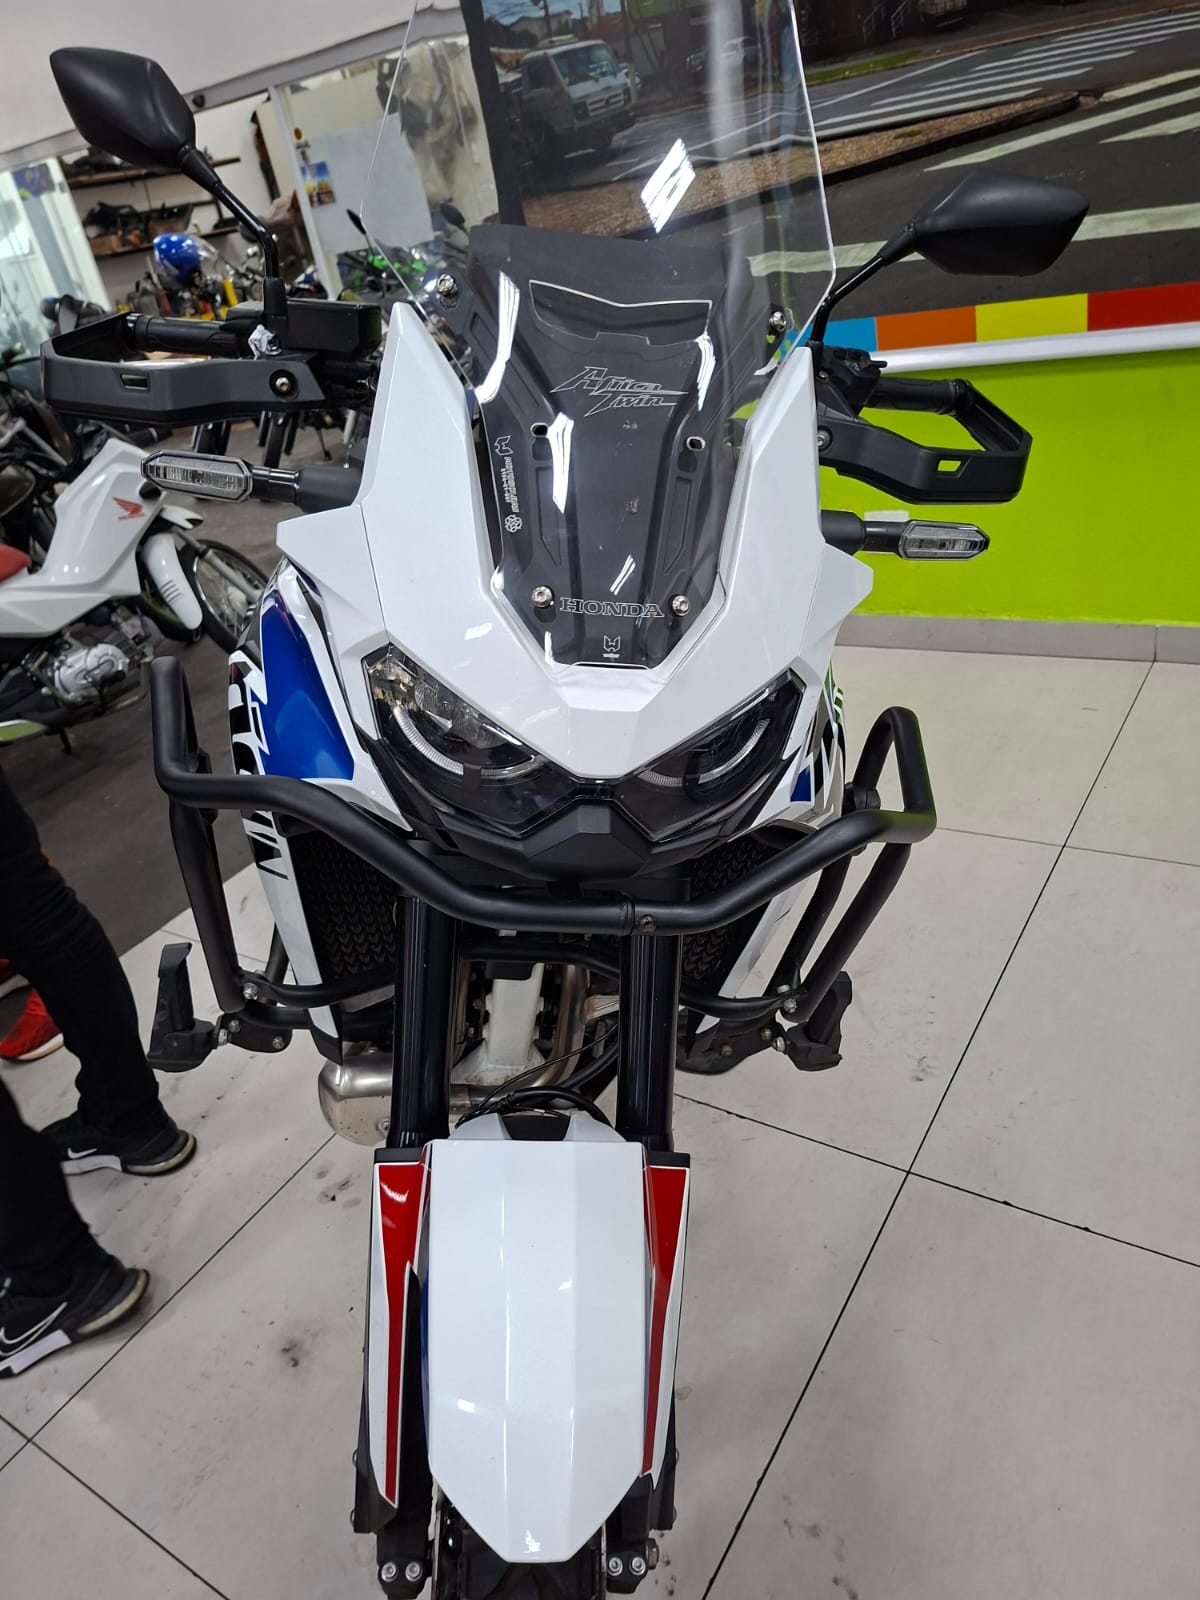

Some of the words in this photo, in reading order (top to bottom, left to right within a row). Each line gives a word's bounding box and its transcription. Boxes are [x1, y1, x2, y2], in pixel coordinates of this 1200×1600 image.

[550, 366, 688, 396] Africa
[584, 393, 677, 417] Twin
[560, 597, 665, 618] HONDA
